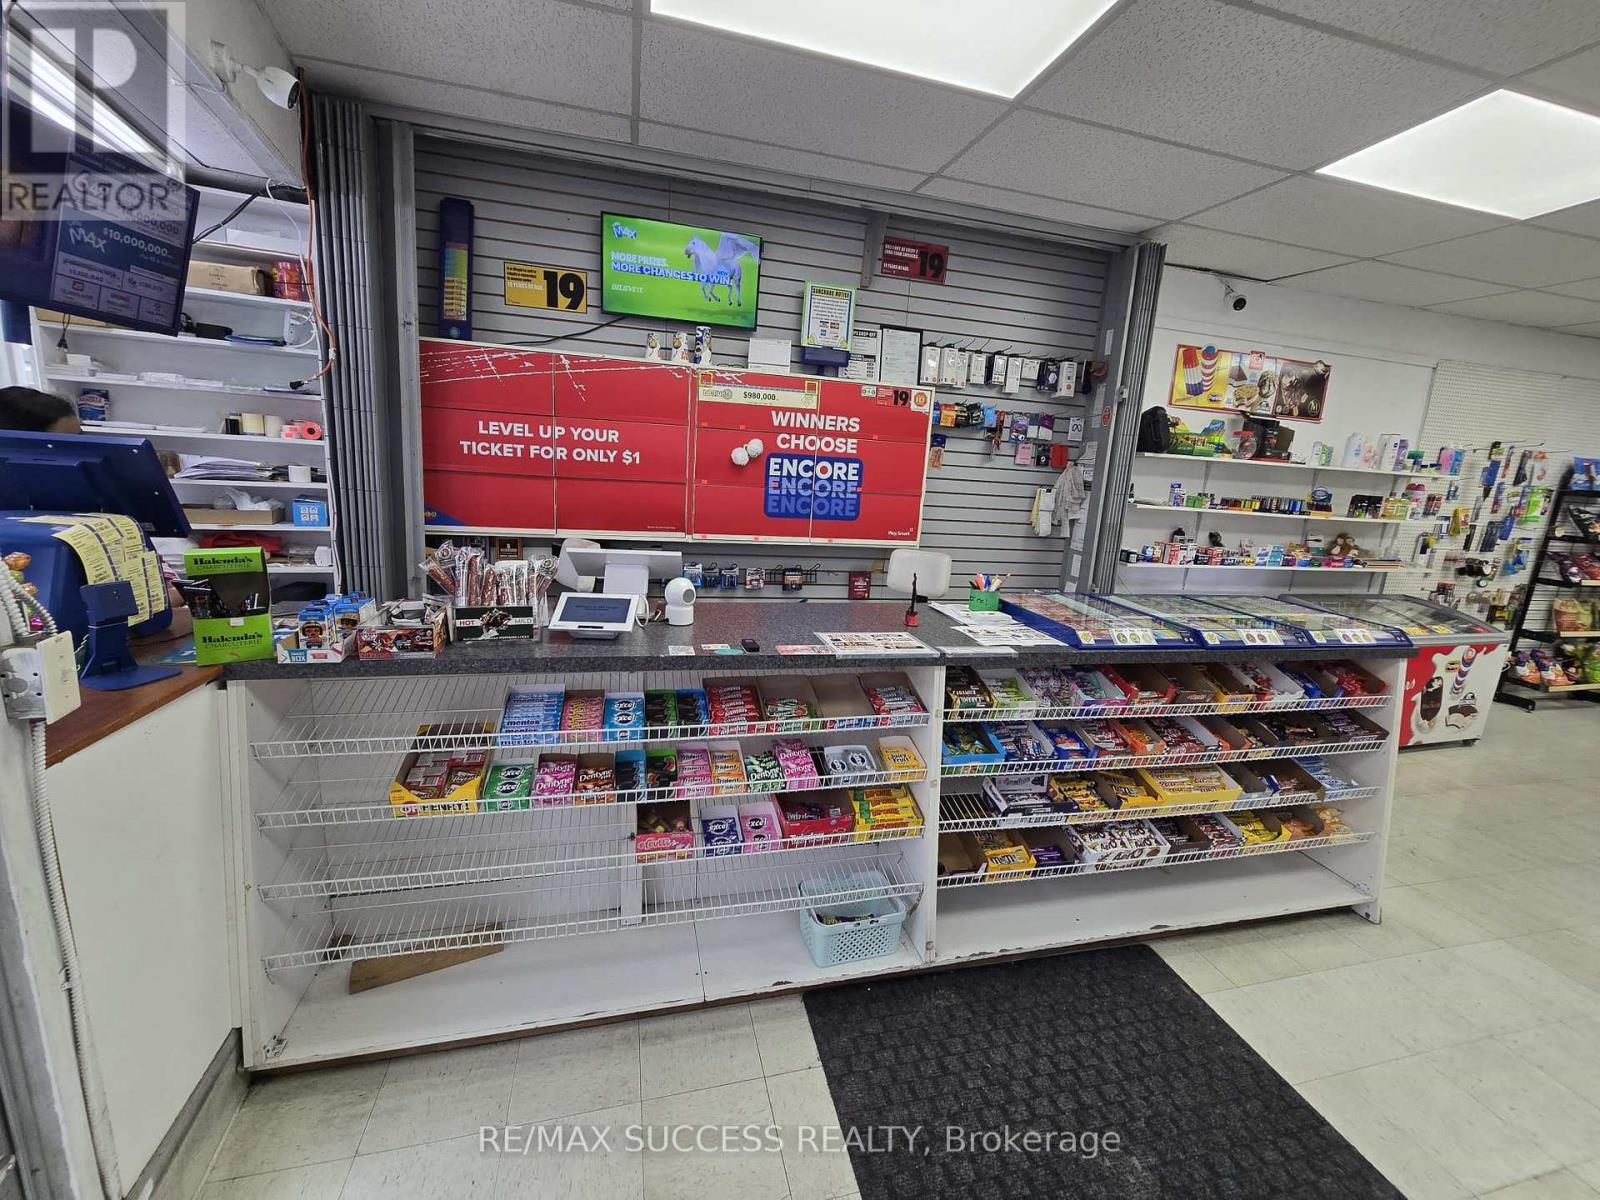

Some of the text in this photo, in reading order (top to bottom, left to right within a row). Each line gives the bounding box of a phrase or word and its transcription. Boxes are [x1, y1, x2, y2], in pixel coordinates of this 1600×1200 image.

[69, 227, 107, 254] MAX
[611, 262, 640, 274] MORE
[920, 251, 944, 278] 19
[543, 270, 585, 310] 19
[893, 389, 909, 406] 19
[478, 420, 620, 443] LEVEL UP YOUR
[771, 410, 861, 433] WINNERS
[459, 440, 641, 466] TICKET FOR ONLY $1
[776, 433, 858, 454] CHOOSE
[769, 457, 860, 481] ENCORE
[768, 476, 858, 499] ENCORE
[767, 498, 857, 517] ENCORE
[193, 556, 253, 565] Halenda's
[202, 632, 263, 643] Halenda's
[536, 777, 572, 791] Dentyne
